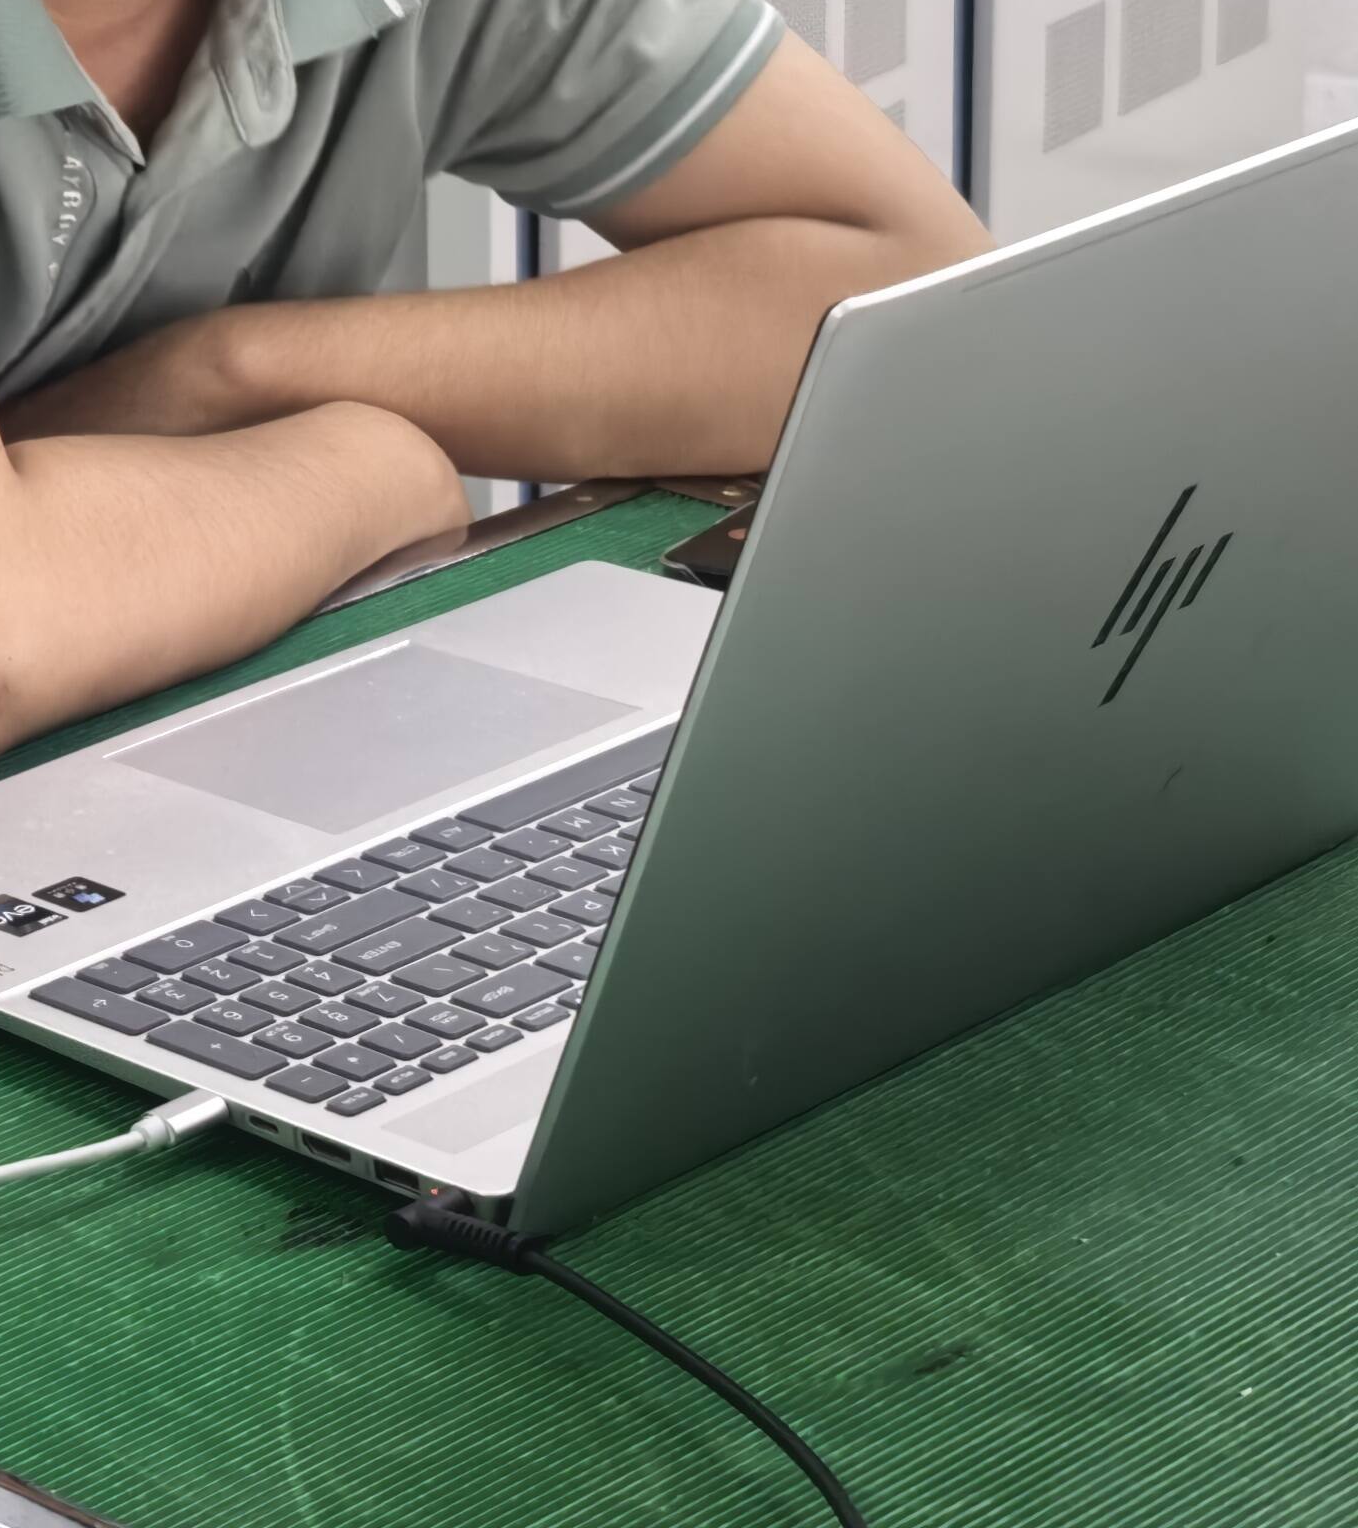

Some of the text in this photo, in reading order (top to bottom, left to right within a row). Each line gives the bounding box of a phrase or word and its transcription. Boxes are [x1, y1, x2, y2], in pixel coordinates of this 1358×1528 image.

[609, 797, 636, 808] N
[564, 816, 591, 829] M
[599, 844, 626, 856] K
[552, 865, 578, 873] L
[357, 940, 402, 961] ENTER
[209, 968, 230, 980] 2
[314, 971, 331, 982] 4
[164, 988, 186, 1001] 3
[268, 990, 290, 1001] 5
[376, 991, 396, 1003] 7
[222, 1010, 243, 1021] 6
[327, 1011, 349, 1022] 8
[282, 1032, 302, 1042] 9
